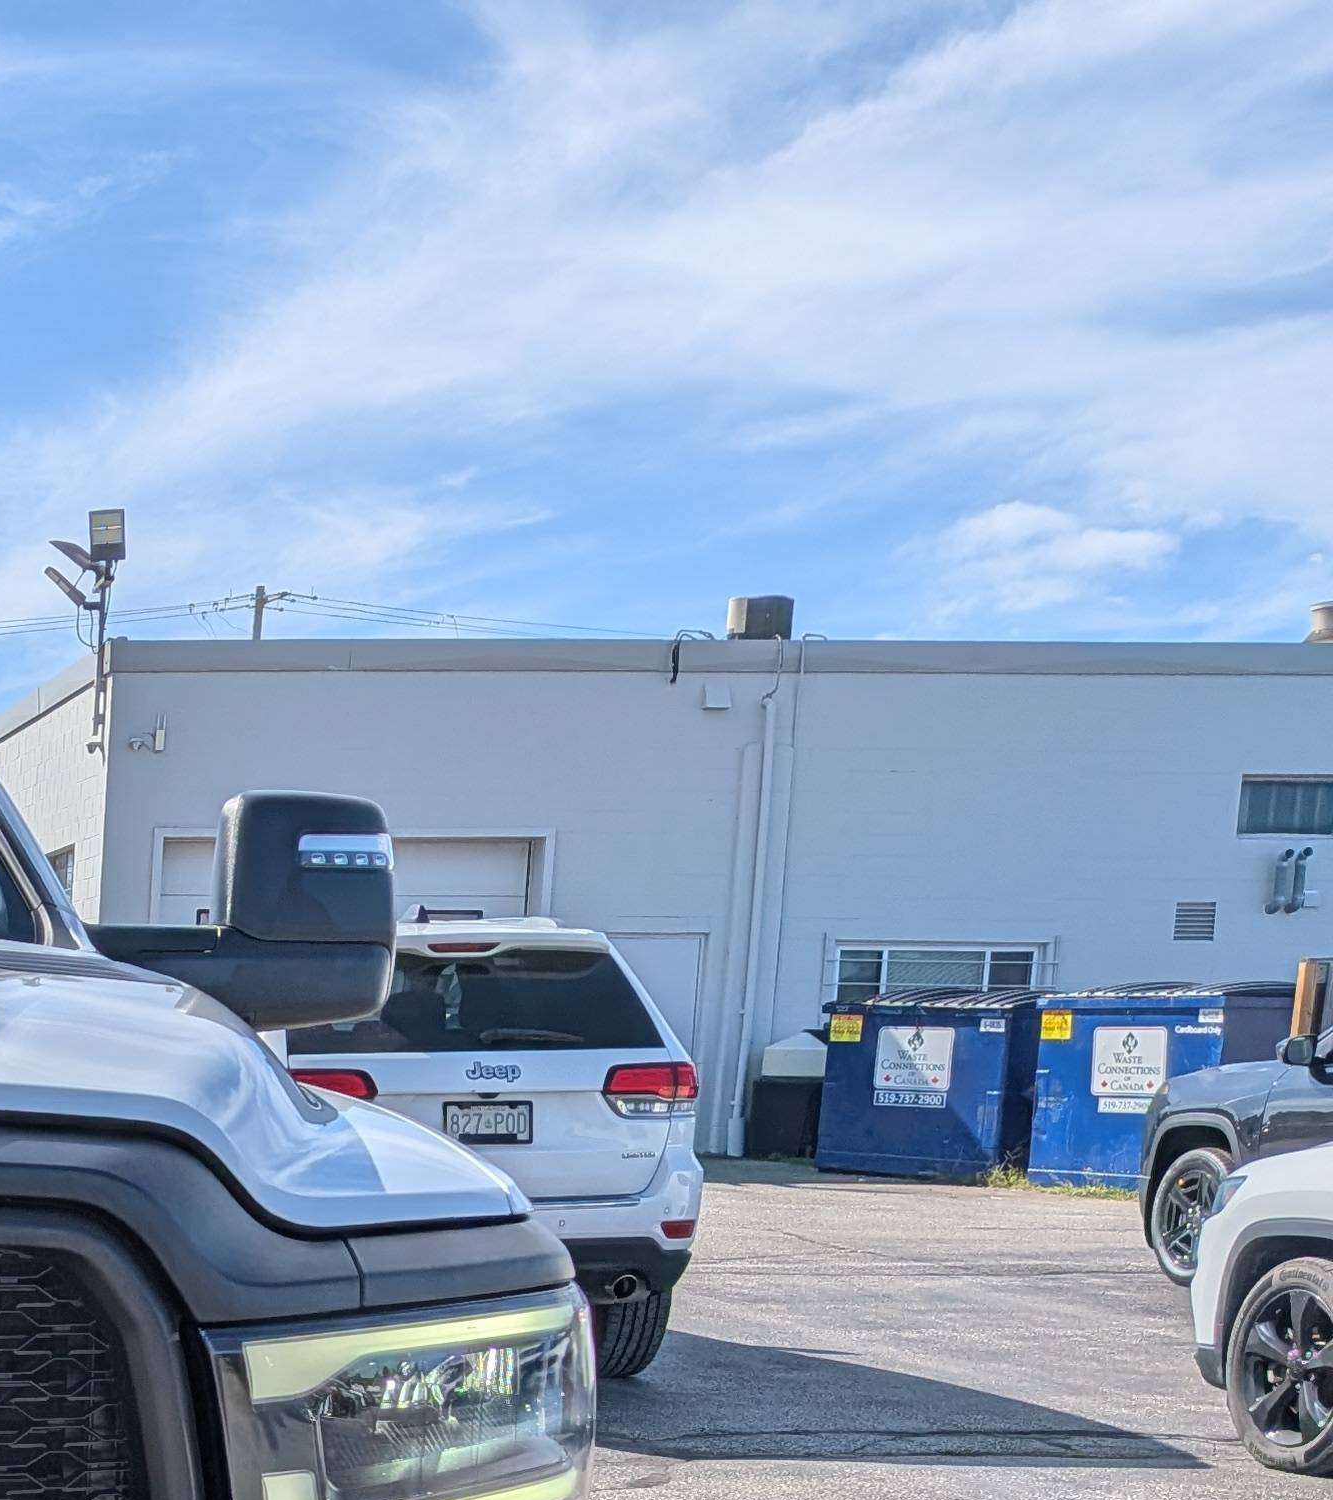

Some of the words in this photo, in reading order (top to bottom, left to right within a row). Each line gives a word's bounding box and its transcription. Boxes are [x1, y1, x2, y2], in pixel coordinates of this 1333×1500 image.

[465, 1061, 522, 1083] Jeep
[878, 1093, 942, 1105] 519-737-2900
[1102, 1100, 1149, 1110] 519-737-290
[450, 1112, 483, 1134] 827
